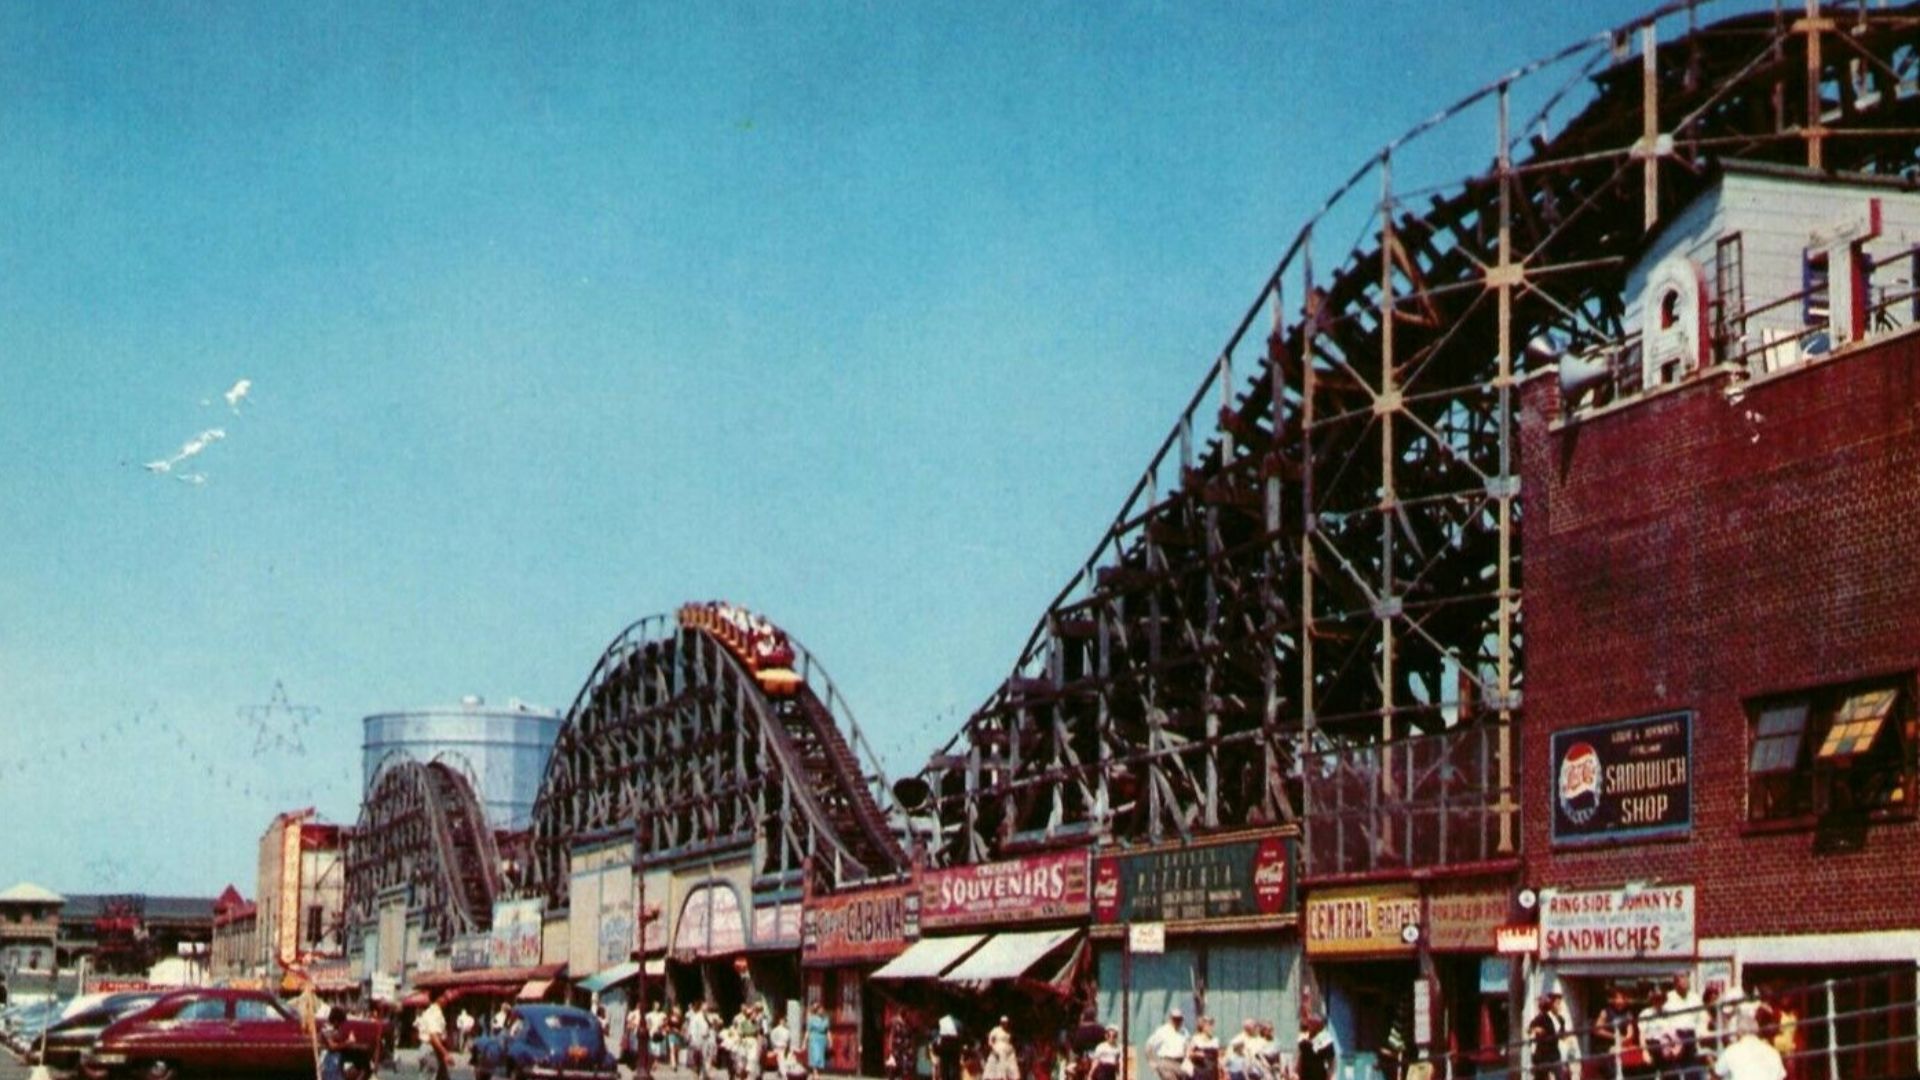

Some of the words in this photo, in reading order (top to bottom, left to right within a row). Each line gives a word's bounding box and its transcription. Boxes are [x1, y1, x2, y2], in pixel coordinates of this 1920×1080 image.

[1605, 757, 1687, 794] SANDWICH
[1621, 794, 1668, 824] SHOP
[940, 862, 1064, 911] SOUVENIRS
[1549, 894, 1613, 914] RINGSIDE
[1618, 889, 1684, 912] JOHNNYS
[847, 897, 902, 942] CABANA
[1310, 898, 1373, 939] CENTRAL
[1377, 901, 1420, 931] BATHS
[1546, 925, 1662, 952] SANDWICHES
